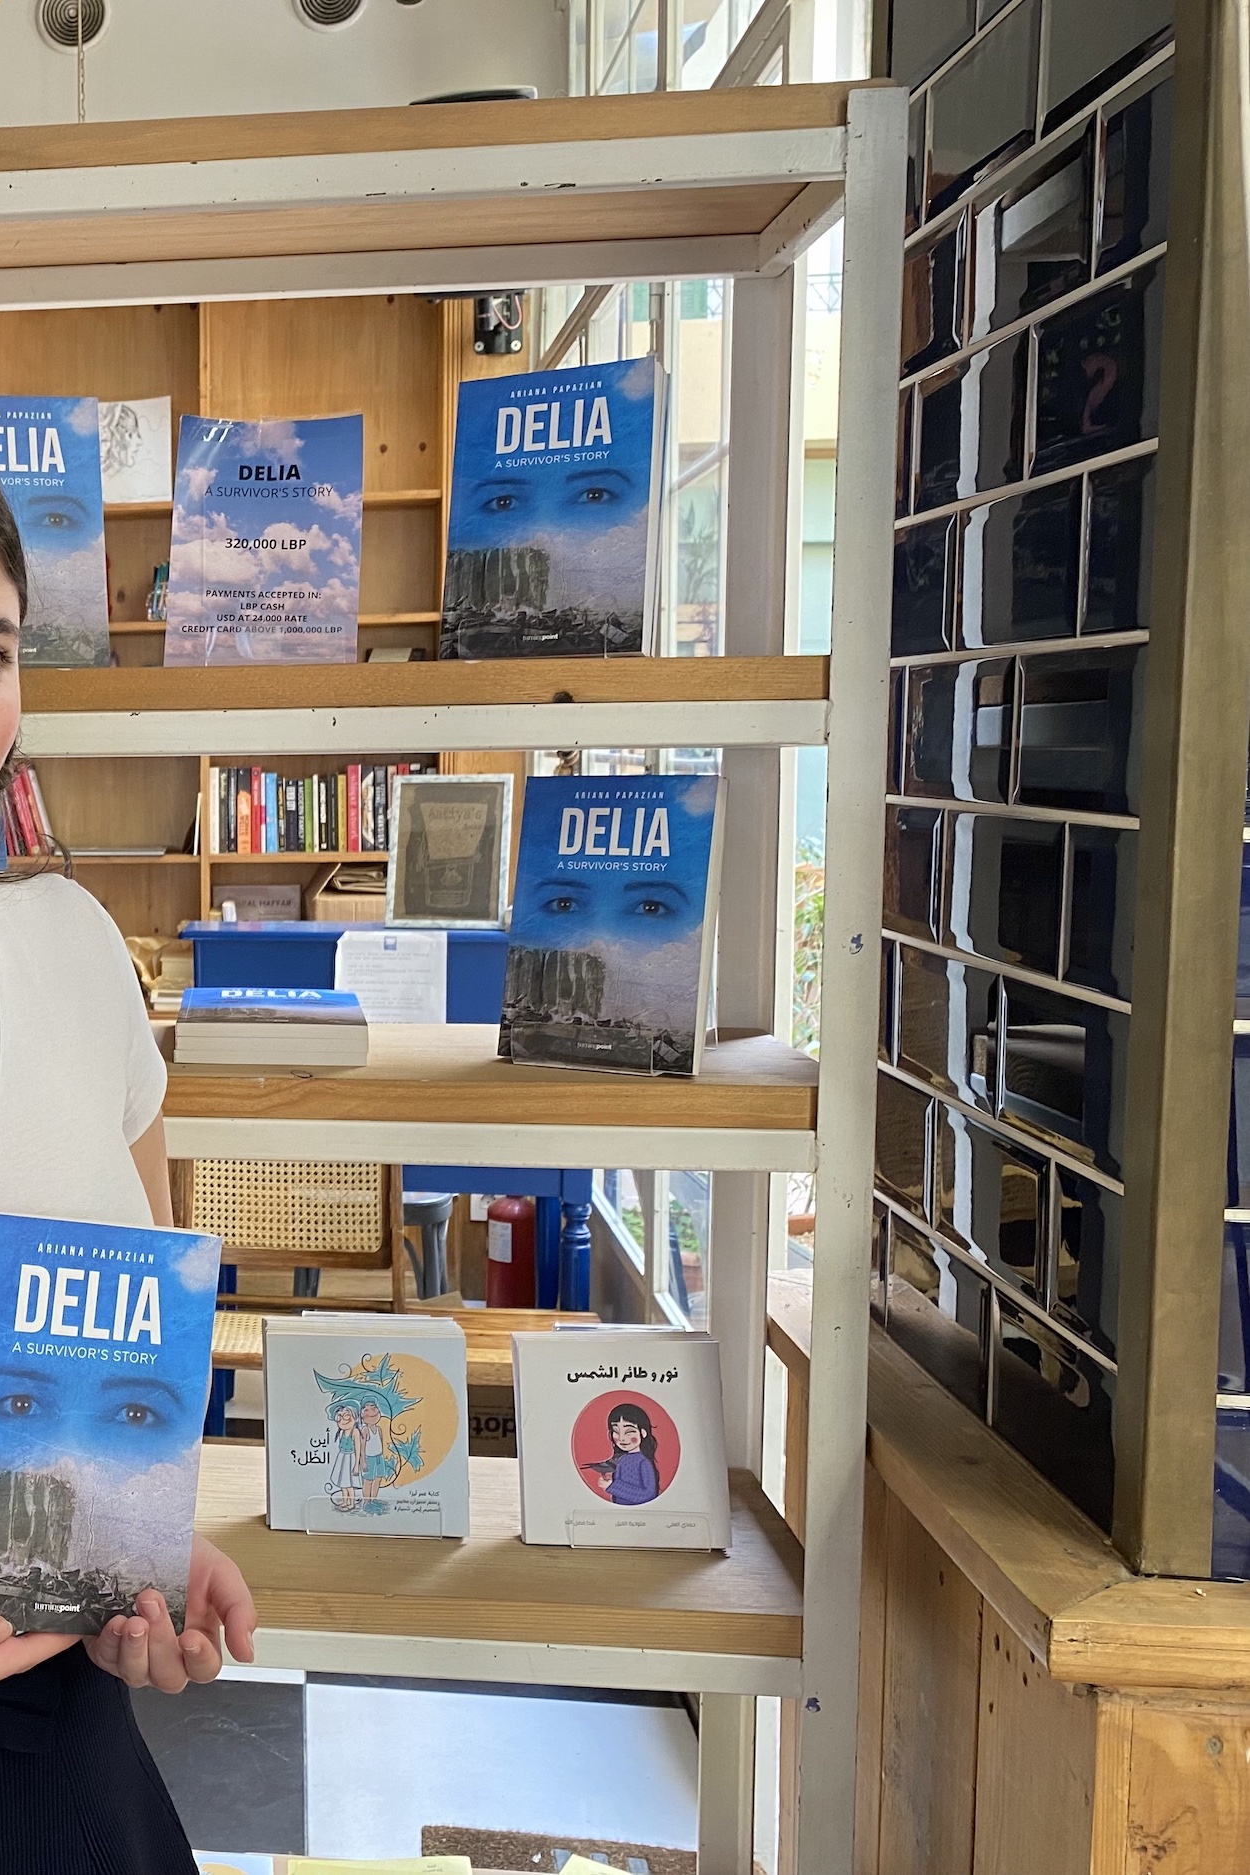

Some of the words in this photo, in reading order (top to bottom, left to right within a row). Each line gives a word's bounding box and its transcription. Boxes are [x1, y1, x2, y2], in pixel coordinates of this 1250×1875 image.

[510, 387, 547, 399] ARIANA
[552, 380, 603, 394] PAPAZIAN
[6, 411, 52, 419] PAPAZIAN
[495, 396, 612, 455] DELIA
[494, 460, 503, 469] A
[505, 454, 571, 468] SURVIVOR'S
[573, 450, 610, 463] STORY
[238, 464, 301, 481] DELIA
[33, 477, 65, 487] STORY
[204, 486, 213, 497] A
[216, 486, 289, 498] SURVIVOR'S
[293, 486, 334, 497] STORY
[225, 538, 277, 550] 320,000
[281, 539, 307, 550] LBP
[205, 589, 256, 599] PAYMENTS
[258, 590, 306, 599] ACCEPTED
[308, 591, 322, 599] IN:
[260, 603, 285, 611] CASH
[216, 614, 236, 622] USD
[237, 614, 250, 622] AT
[252, 614, 282, 623] 24,000
[284, 615, 308, 623] RATE
[181, 625, 215, 633] CREDIT
[216, 625, 242, 633] CARD
[244, 626, 277, 634] ABOVE
[279, 626, 322, 634] 1,000,000
[324, 626, 343, 634] LBP
[574, 791, 610, 800] ARIANA
[615, 791, 665, 800] PAPAZIAN
[558, 807, 671, 857] DELIA
[556, 861, 565, 870] A
[567, 860, 630, 871] SURVIVOR'S
[632, 862, 668, 872] STORY
[221, 989, 323, 999] DELIA
[37, 1242, 84, 1257] ARIANA
[92, 1247, 155, 1264] PAPAZIAN
[14, 1263, 162, 1345] DELIA
[11, 1341, 22, 1353] A
[26, 1343, 109, 1361] SURVIVOR'S
[113, 1350, 158, 1365] STORY
[567, 1365, 618, 1383] الشمس
[620, 1366, 648, 1383] طائر
[659, 1366, 679, 1383] نور
[309, 1427, 330, 1448] أين
